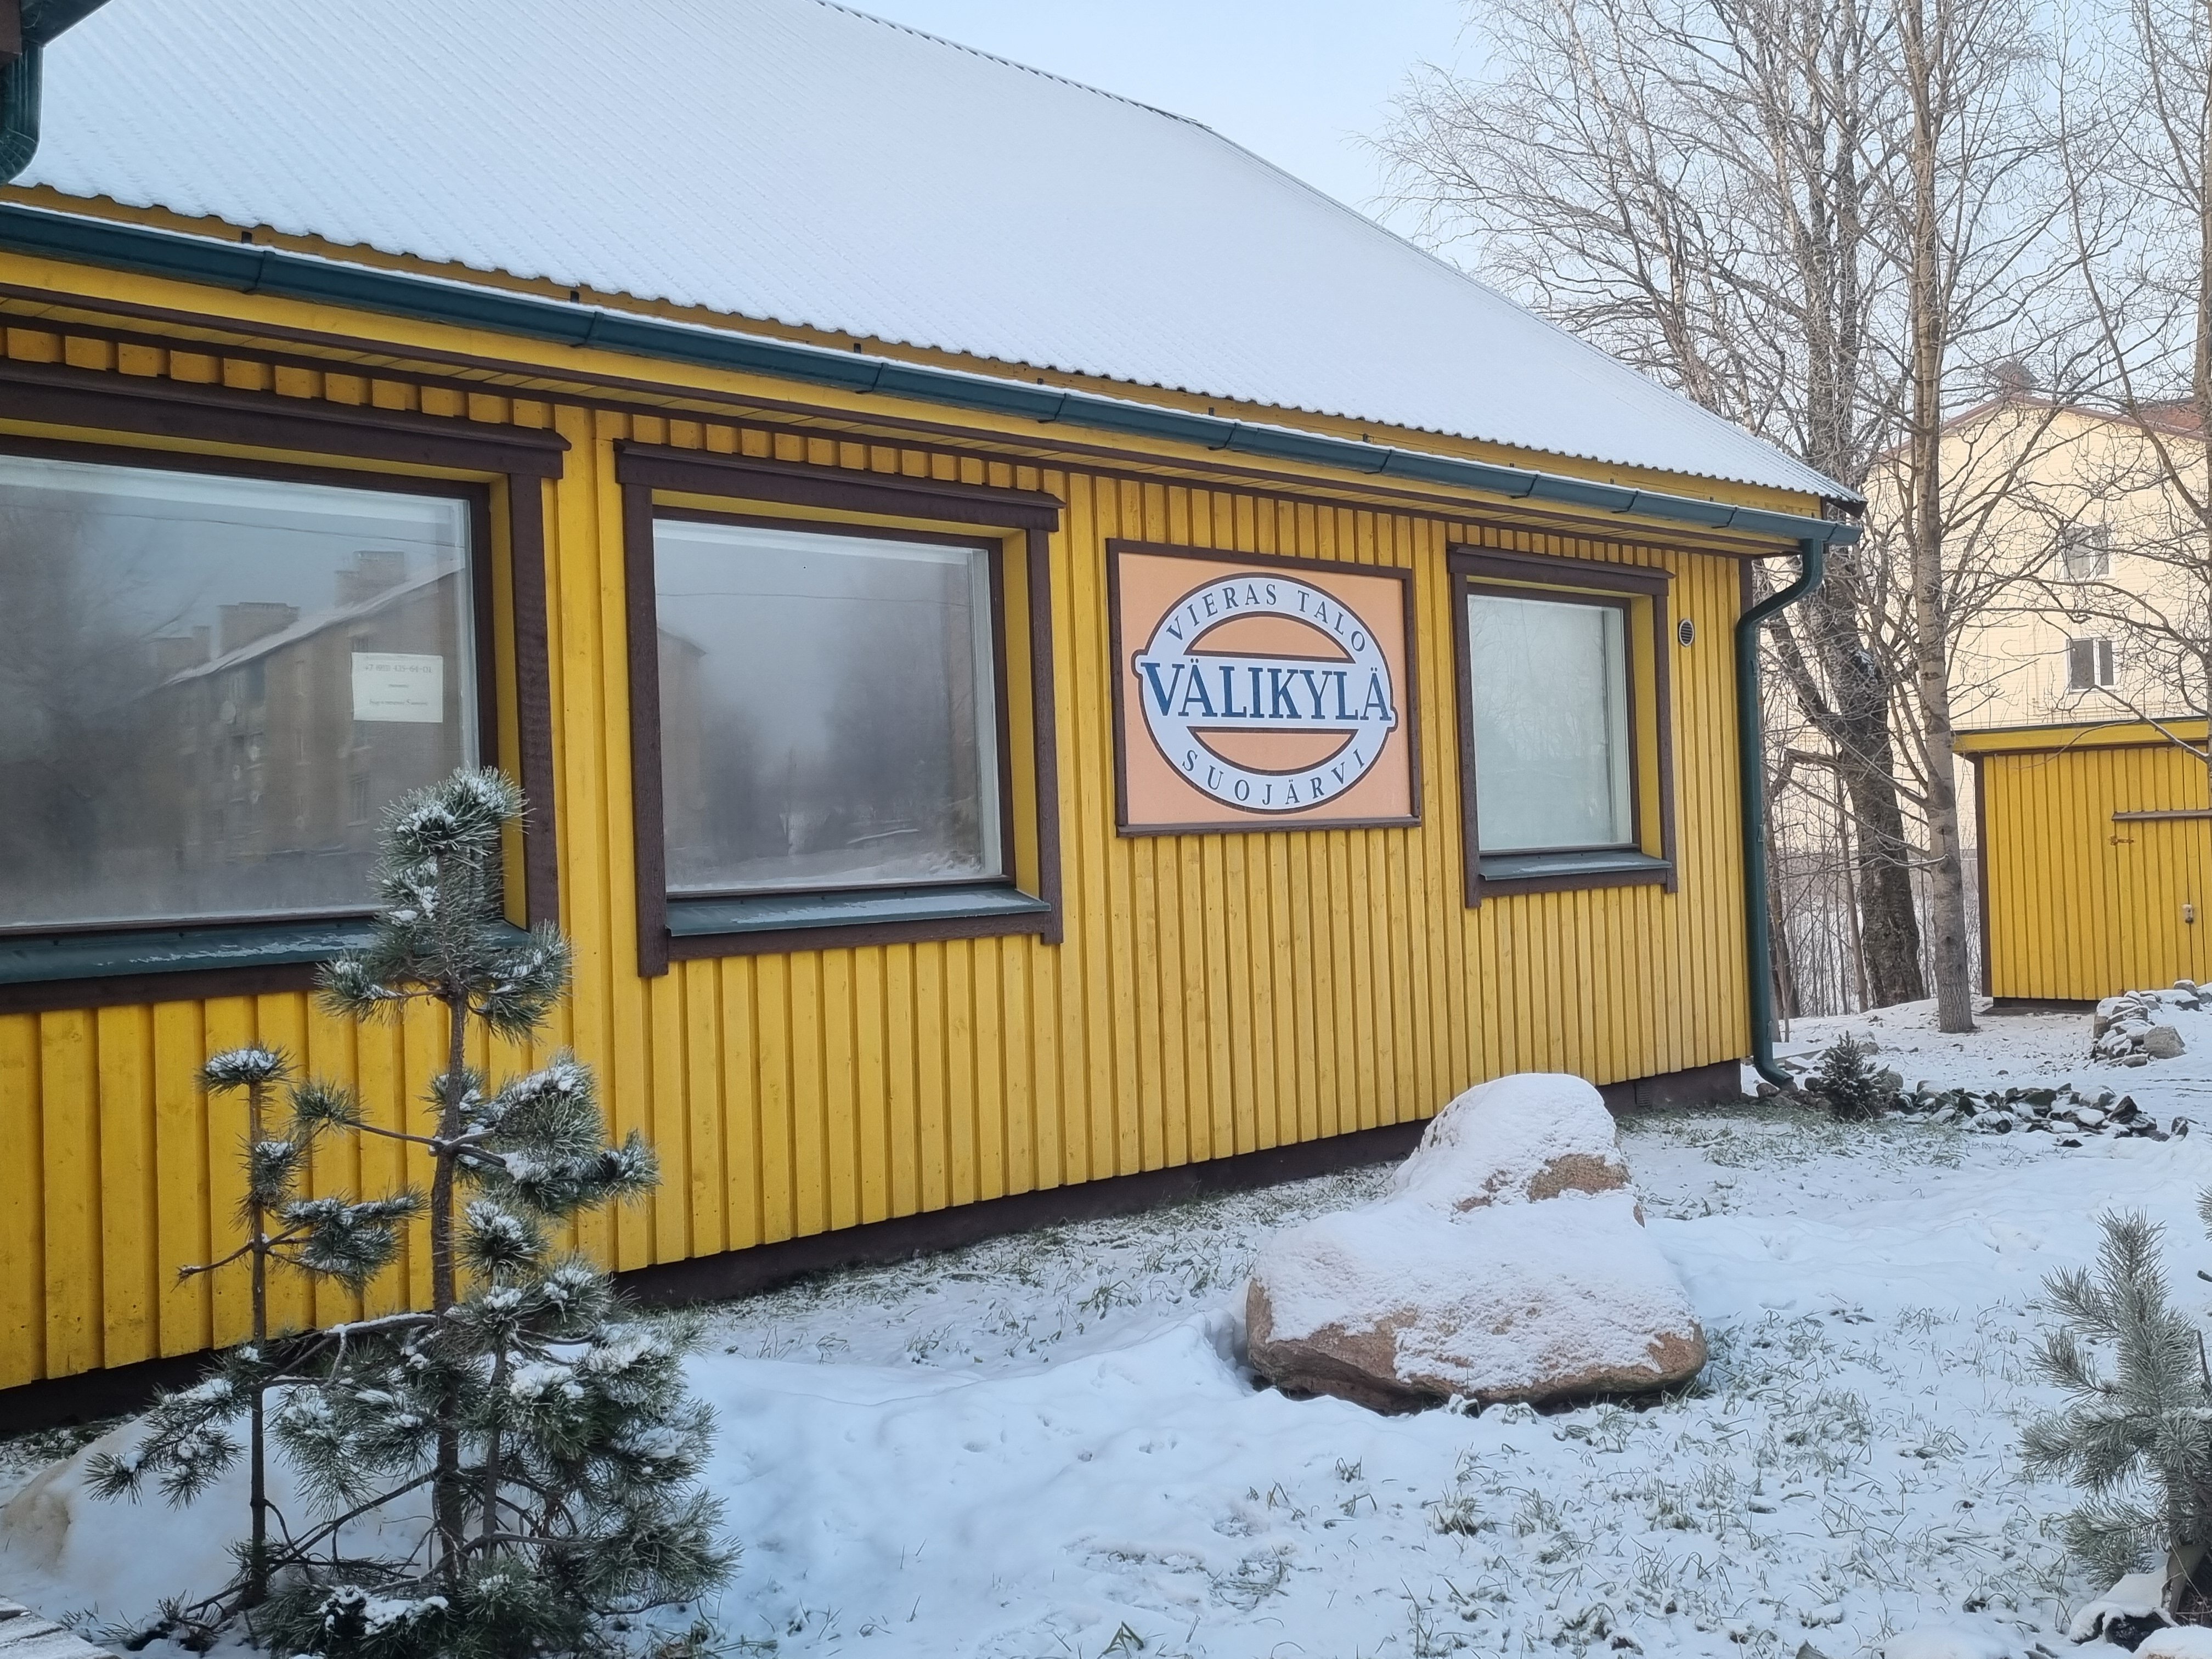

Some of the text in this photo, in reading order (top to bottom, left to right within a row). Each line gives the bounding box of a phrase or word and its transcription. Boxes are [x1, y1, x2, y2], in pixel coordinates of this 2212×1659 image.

[1166, 583, 1366, 653] VIERAS TALO
[1140, 658, 1392, 721] VÄLIKYLÄ
[1181, 748, 1365, 806] SUOJÄRVI
